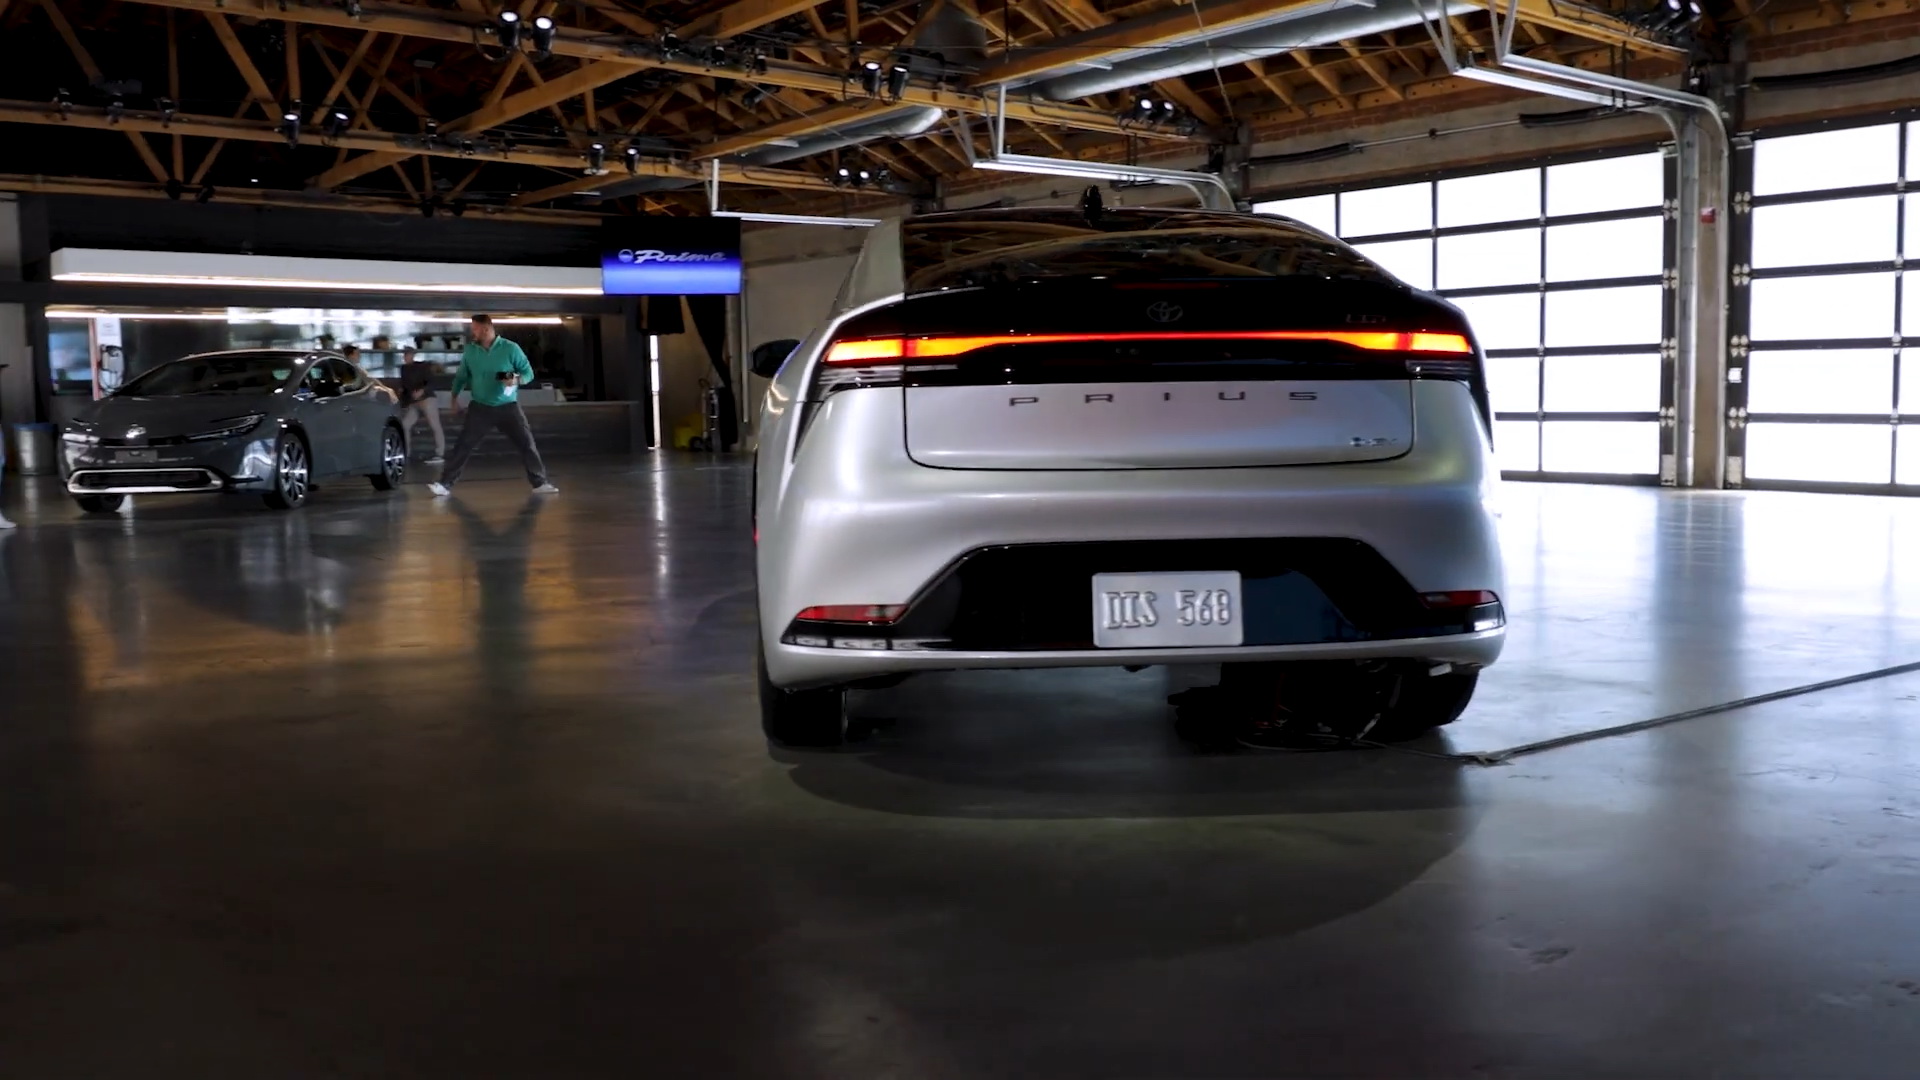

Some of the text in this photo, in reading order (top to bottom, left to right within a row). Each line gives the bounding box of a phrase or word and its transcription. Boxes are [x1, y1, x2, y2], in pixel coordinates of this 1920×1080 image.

[1008, 391, 1318, 407] PRIUS
[1101, 588, 1232, 630] DIS 568
